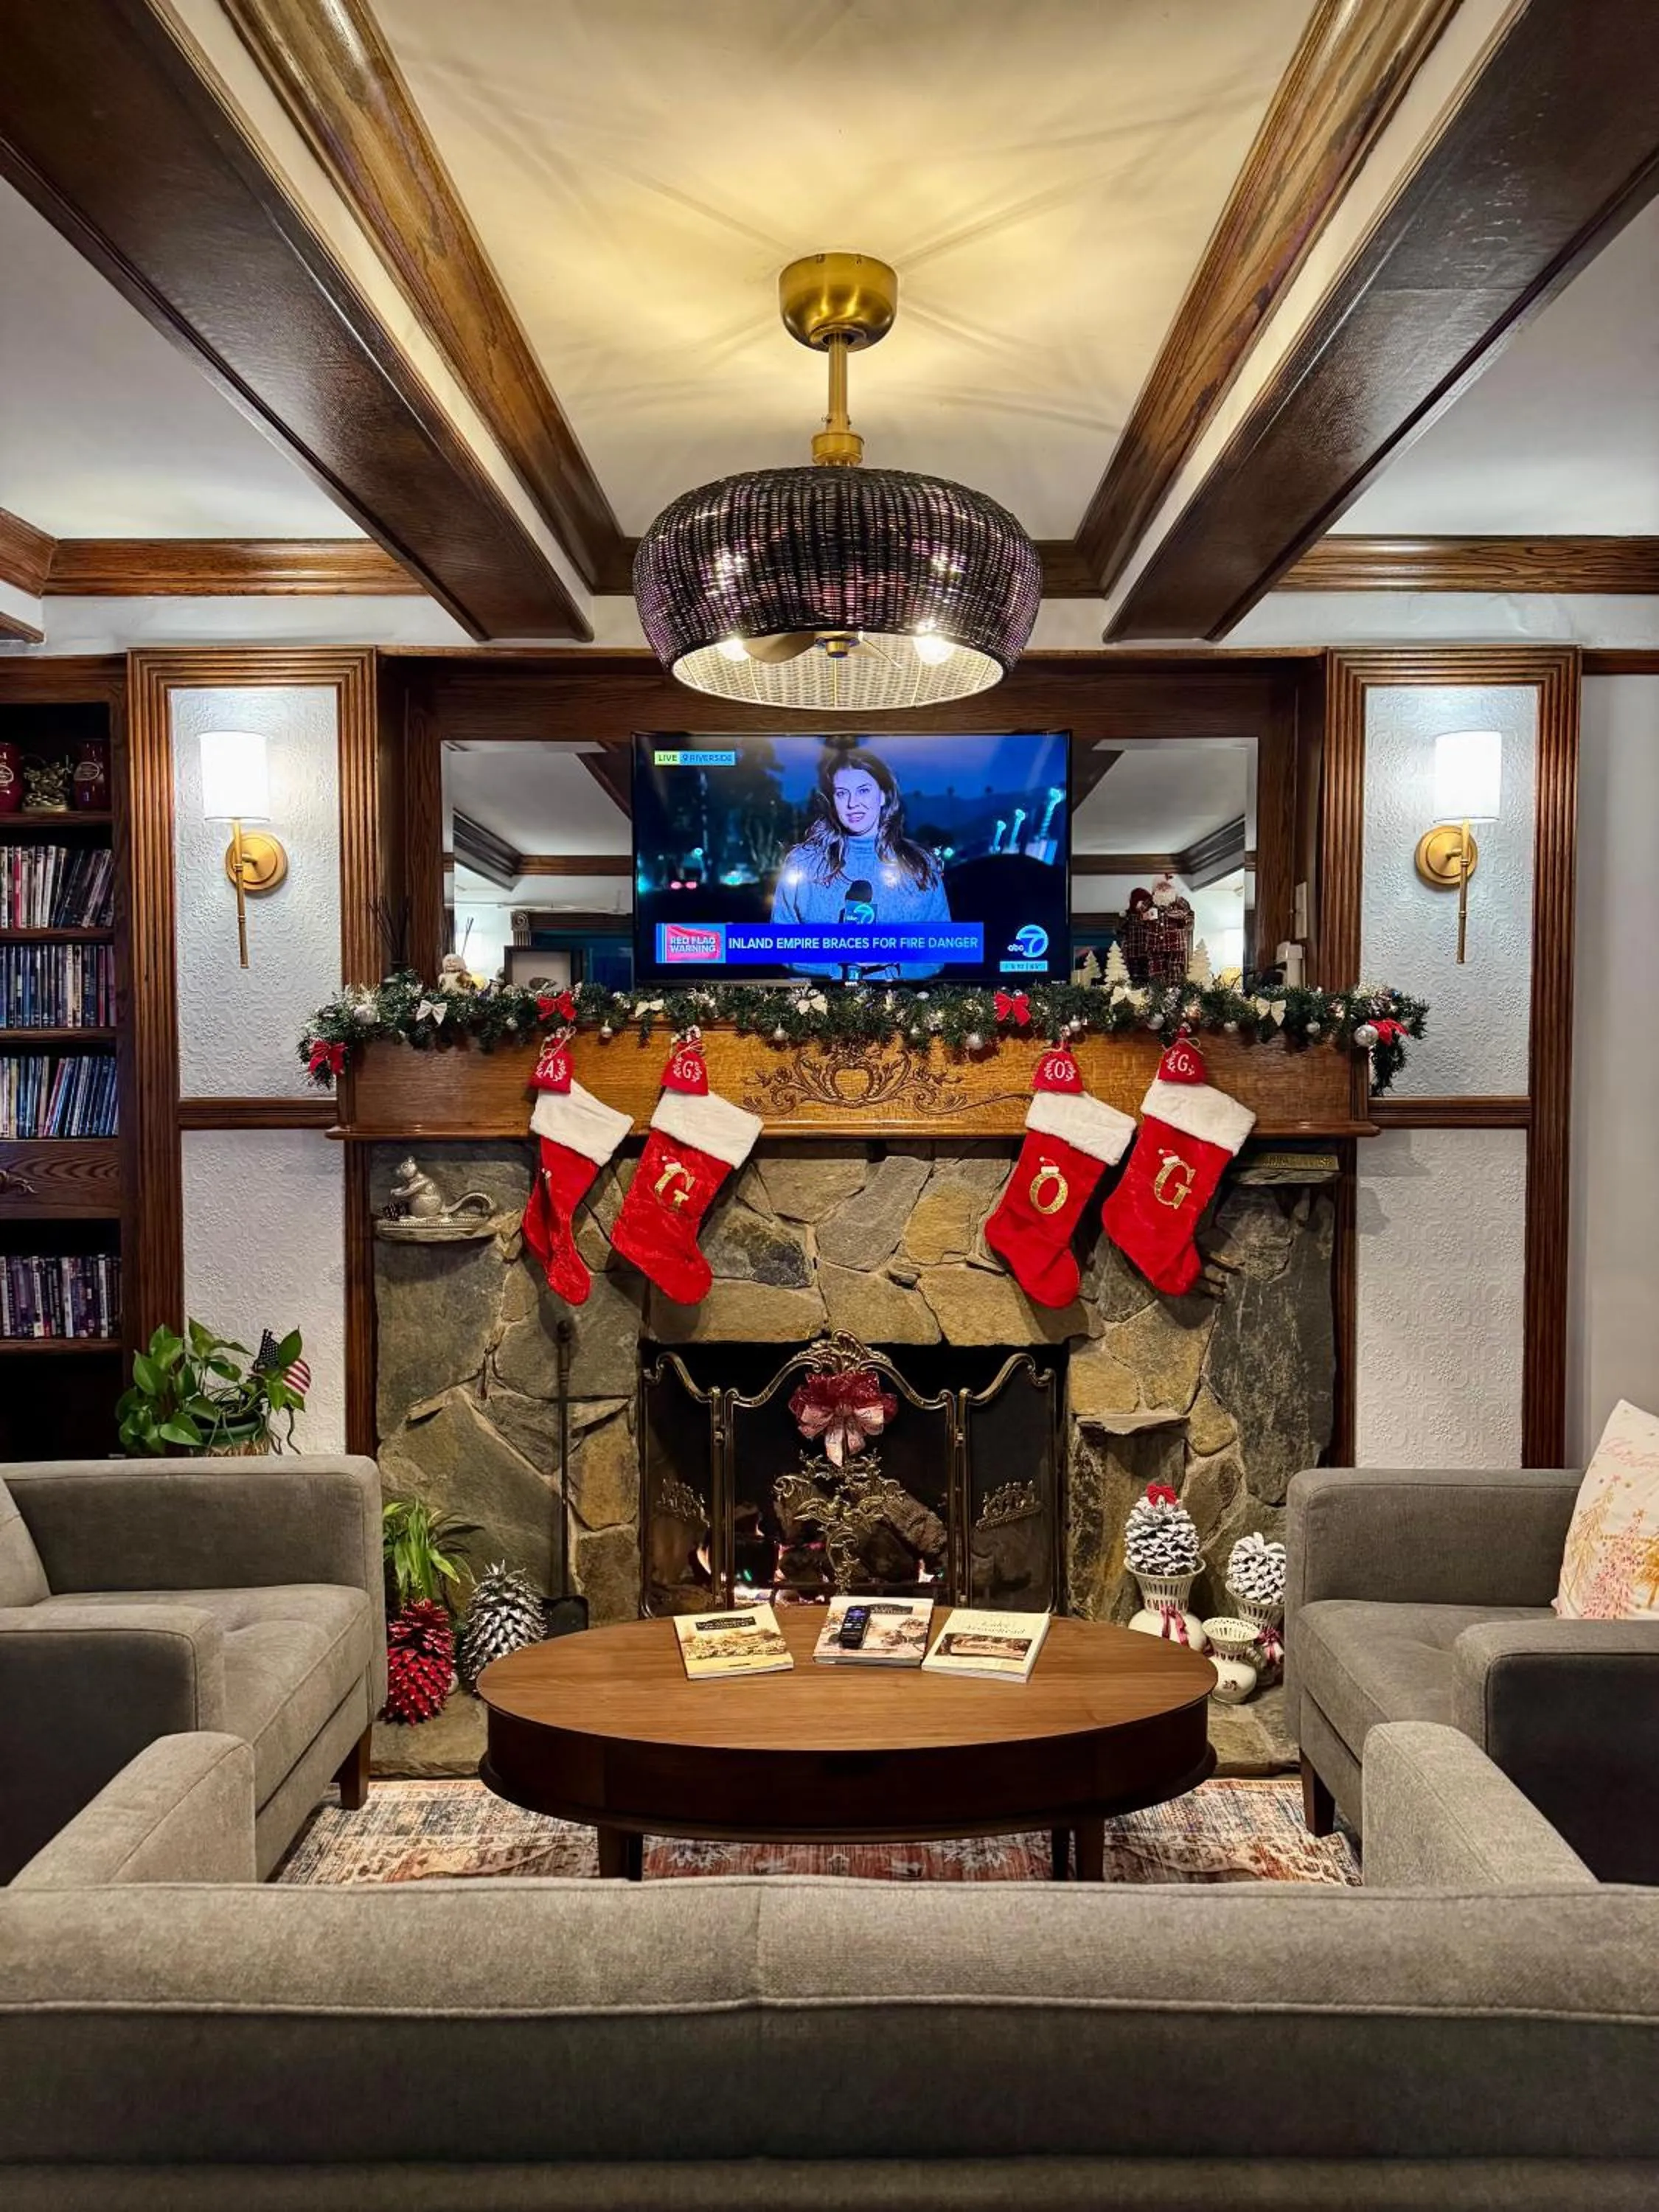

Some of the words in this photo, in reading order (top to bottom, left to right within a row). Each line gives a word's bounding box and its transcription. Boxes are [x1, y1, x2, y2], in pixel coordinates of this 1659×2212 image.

[669, 945, 716, 953] WARNING
[670, 936, 689, 945] RED
[728, 937, 773, 949] INLAND
[776, 937, 820, 949] EMPIRE
[822, 937, 869, 949] BRACES
[872, 937, 897, 949] FOR
[900, 937, 925, 949] FIRE
[928, 937, 978, 949] DANGER
[543, 1060, 554, 1079] A
[681, 1060, 694, 1079] G
[1177, 1054, 1189, 1072] G
[654, 1164, 696, 1214] G
[1029, 1172, 1068, 1214] O
[1155, 1161, 1196, 1209] G
